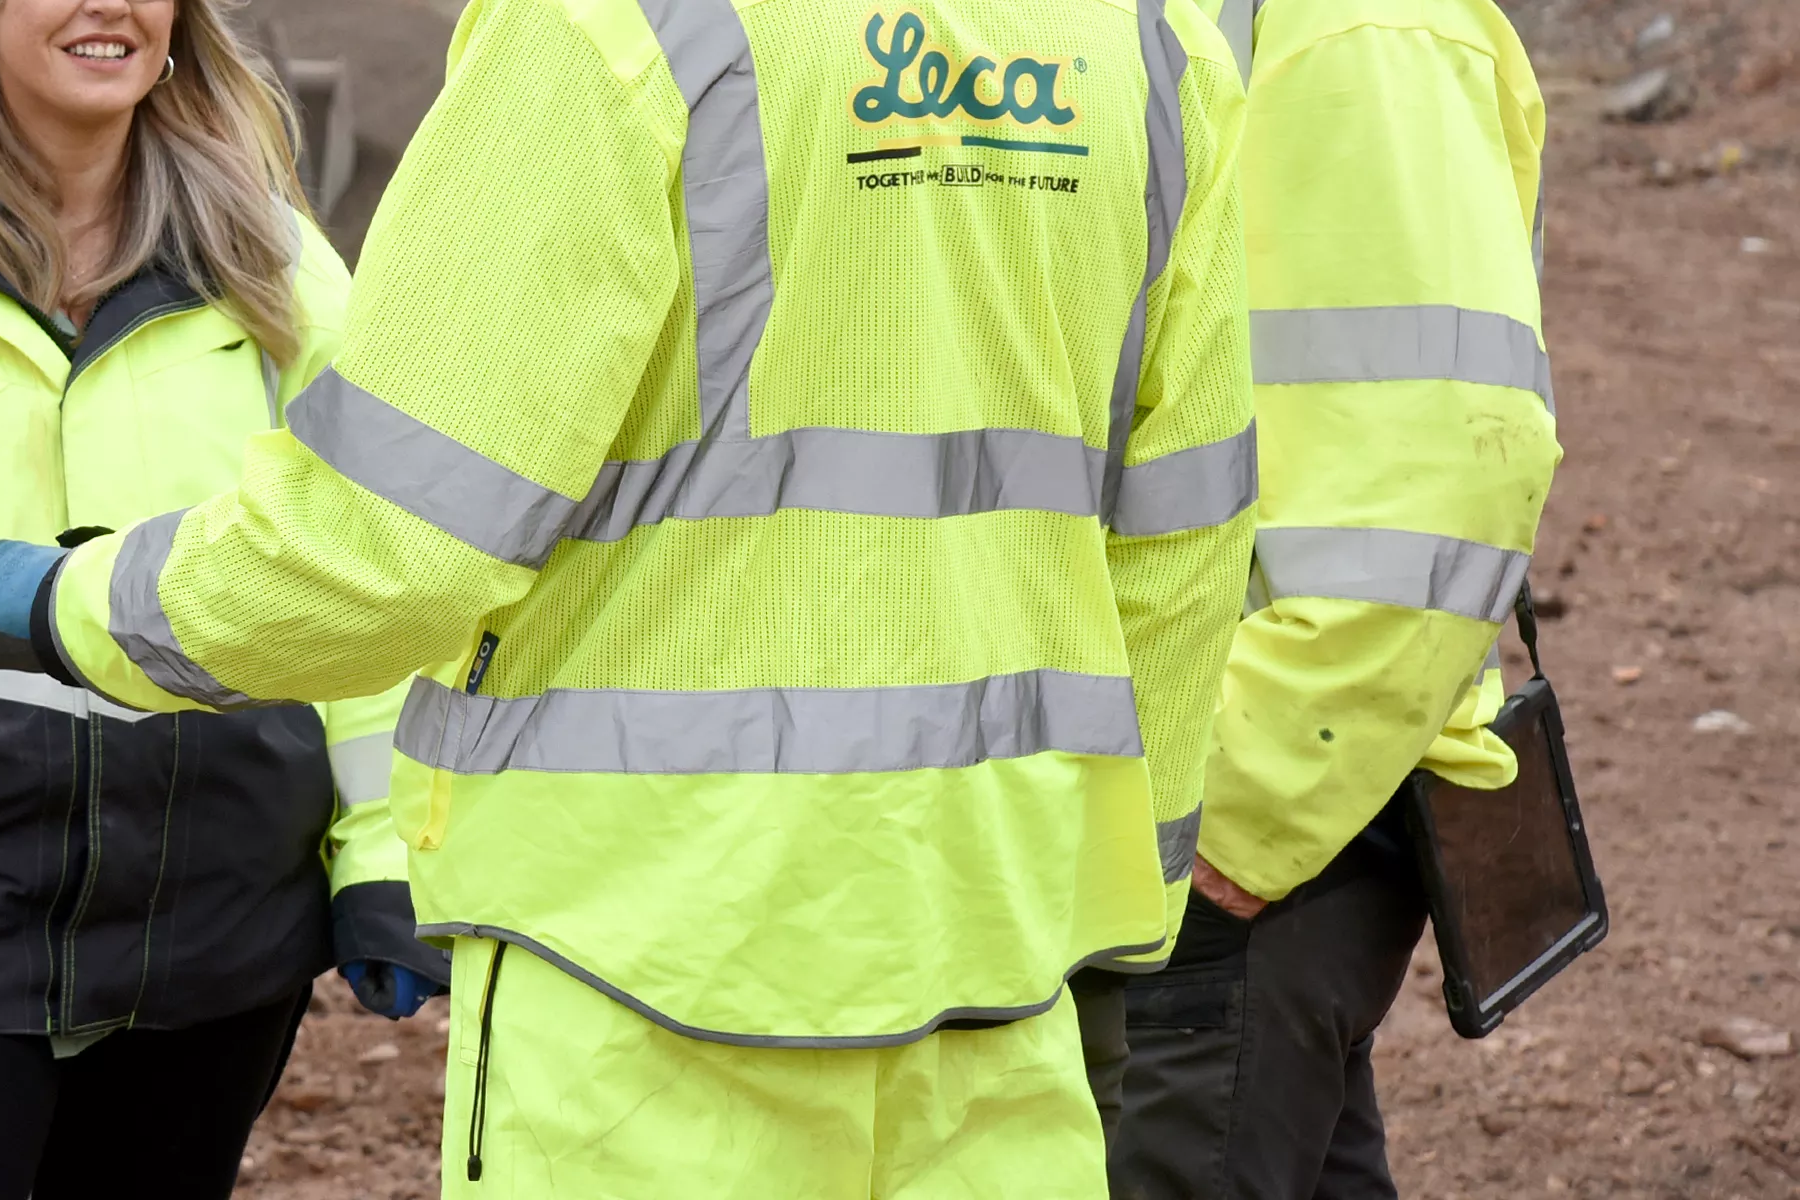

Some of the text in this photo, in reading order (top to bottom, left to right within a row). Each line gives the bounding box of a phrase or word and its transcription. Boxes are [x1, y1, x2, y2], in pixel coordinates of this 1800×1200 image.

[853, 11, 1076, 126] Leca
[856, 171, 925, 191] TOGETHER
[944, 167, 982, 184] BUILD
[985, 173, 1005, 184] FOR
[1008, 175, 1026, 188] THE
[1029, 175, 1079, 194] FUTURE
